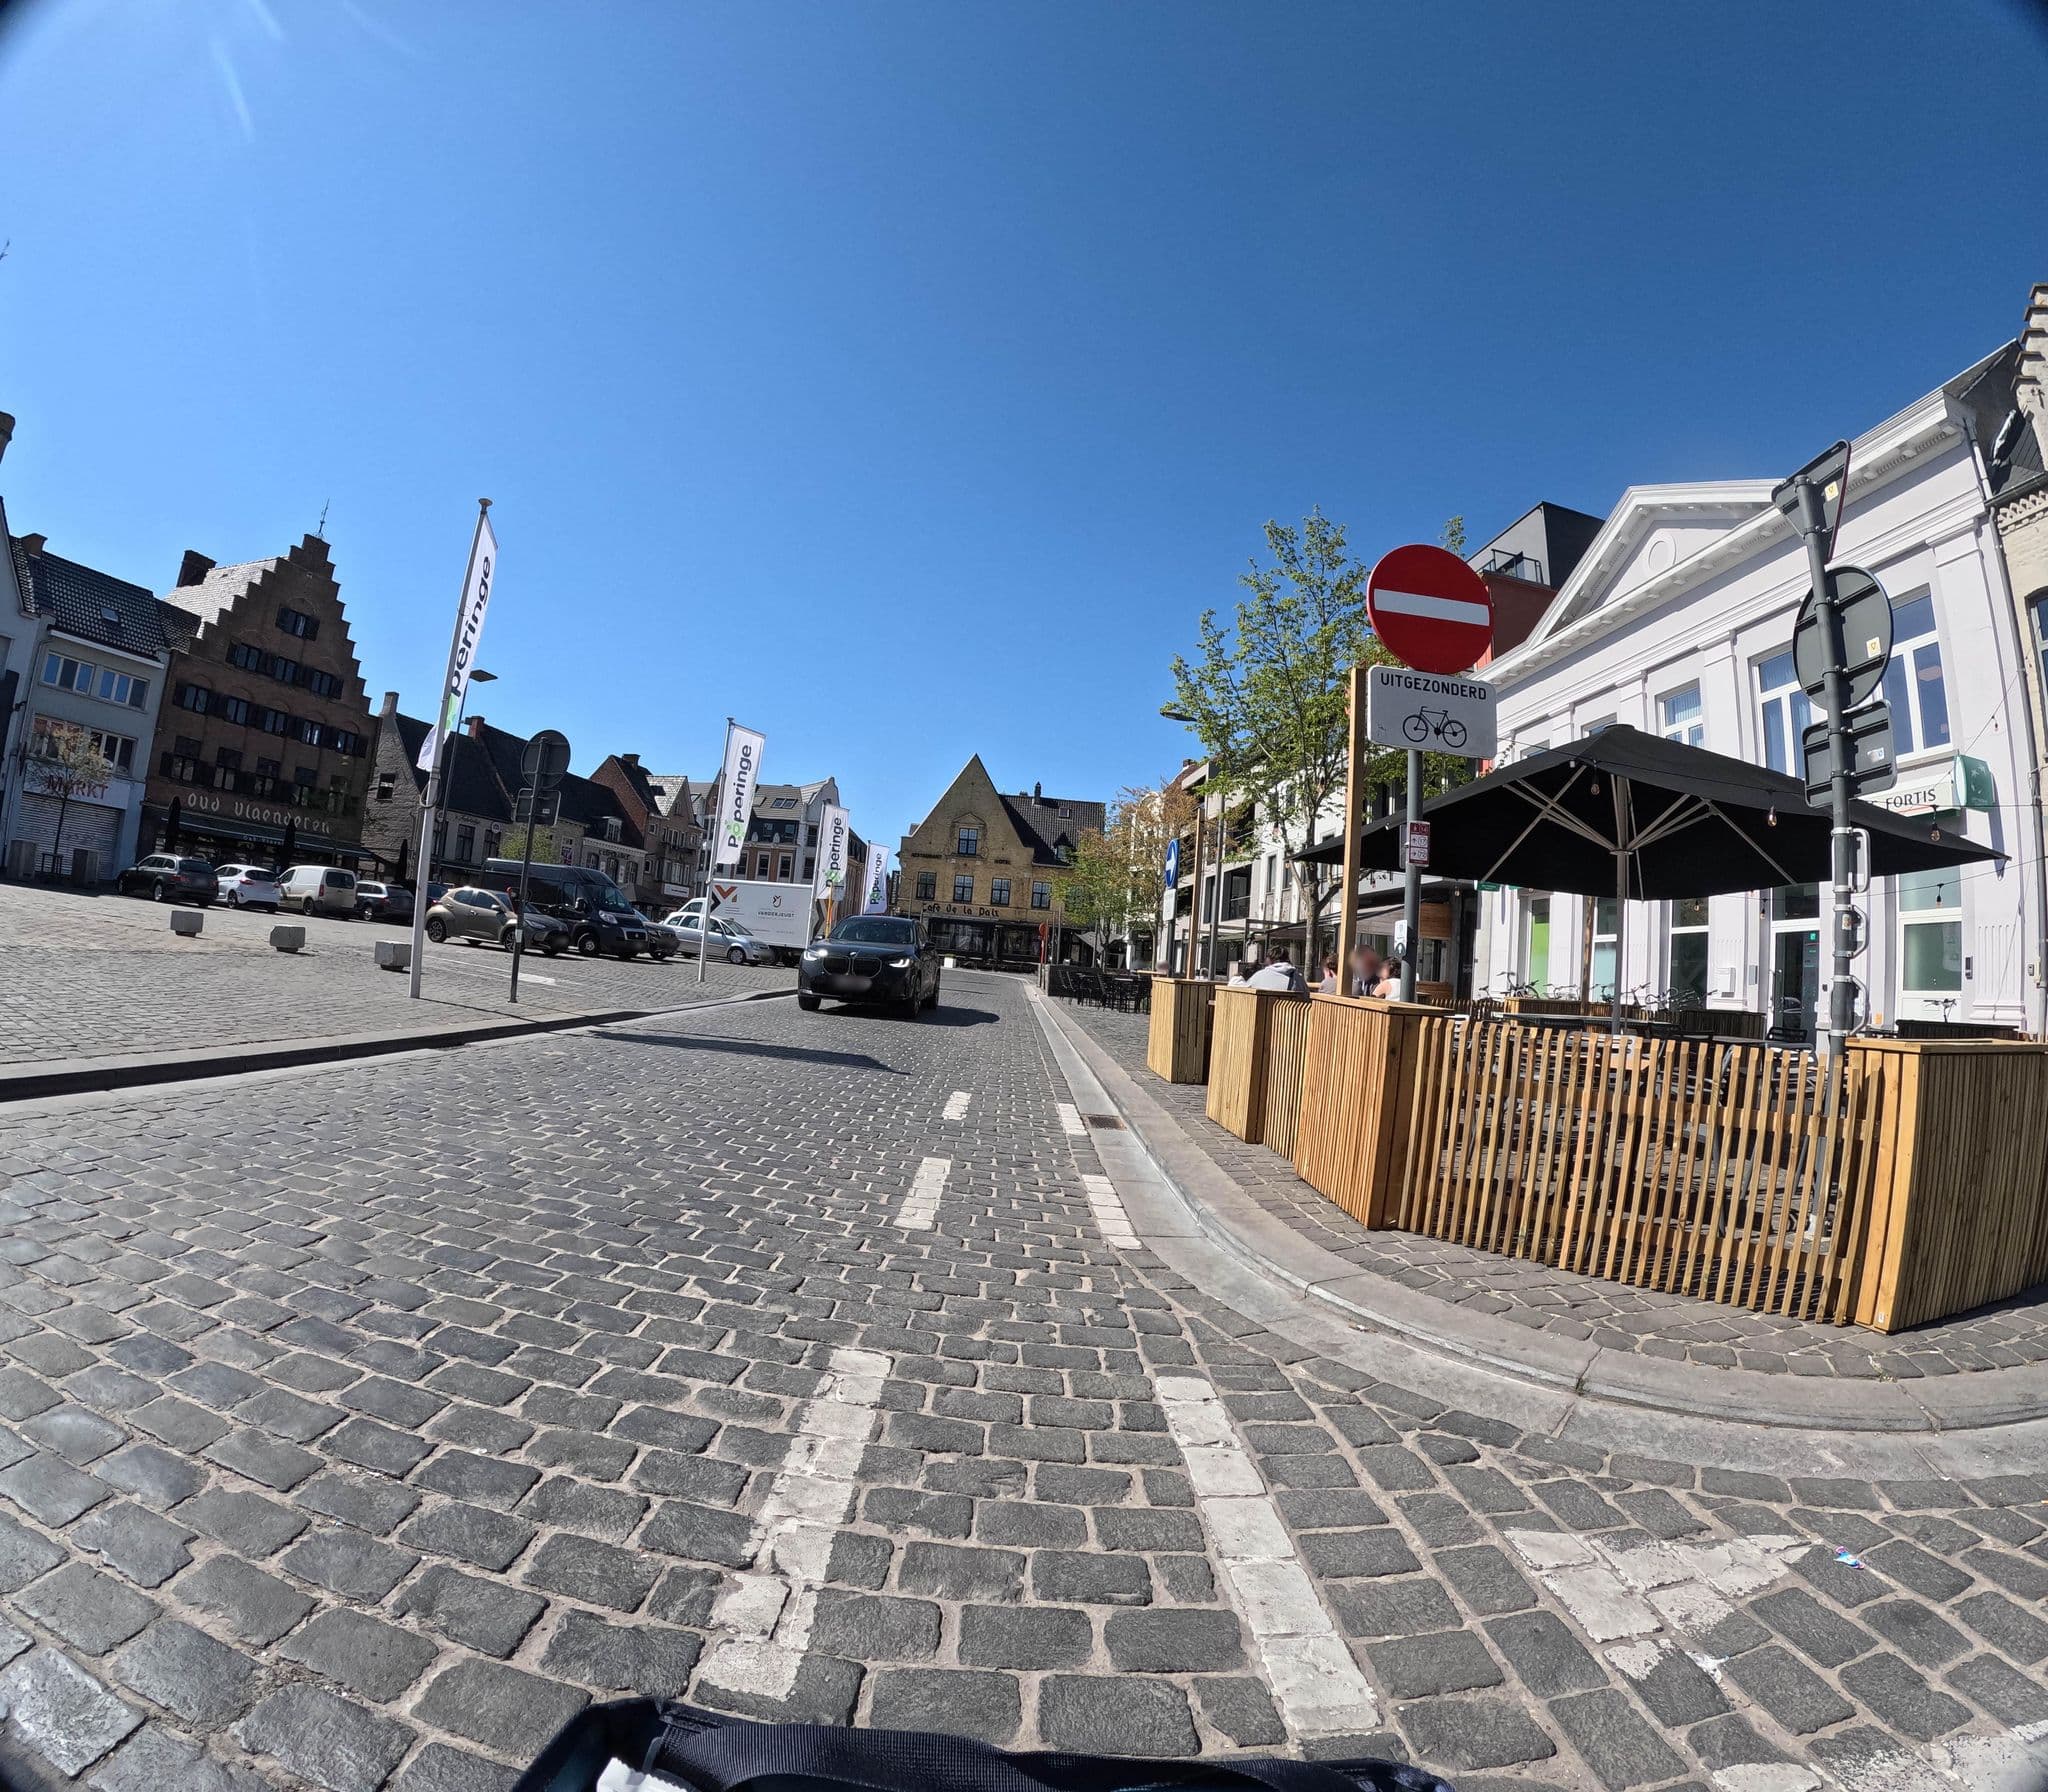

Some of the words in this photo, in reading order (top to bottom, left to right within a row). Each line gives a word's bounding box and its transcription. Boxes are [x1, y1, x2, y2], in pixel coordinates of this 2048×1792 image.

[449, 556, 491, 697] peringe
[1380, 673, 1487, 700] UITGEZONDERD
[727, 744, 752, 848] Poperinge
[1885, 788, 1937, 811] FORTIS
[826, 817, 844, 888] Poperinge
[869, 853, 883, 905] Poperinge
